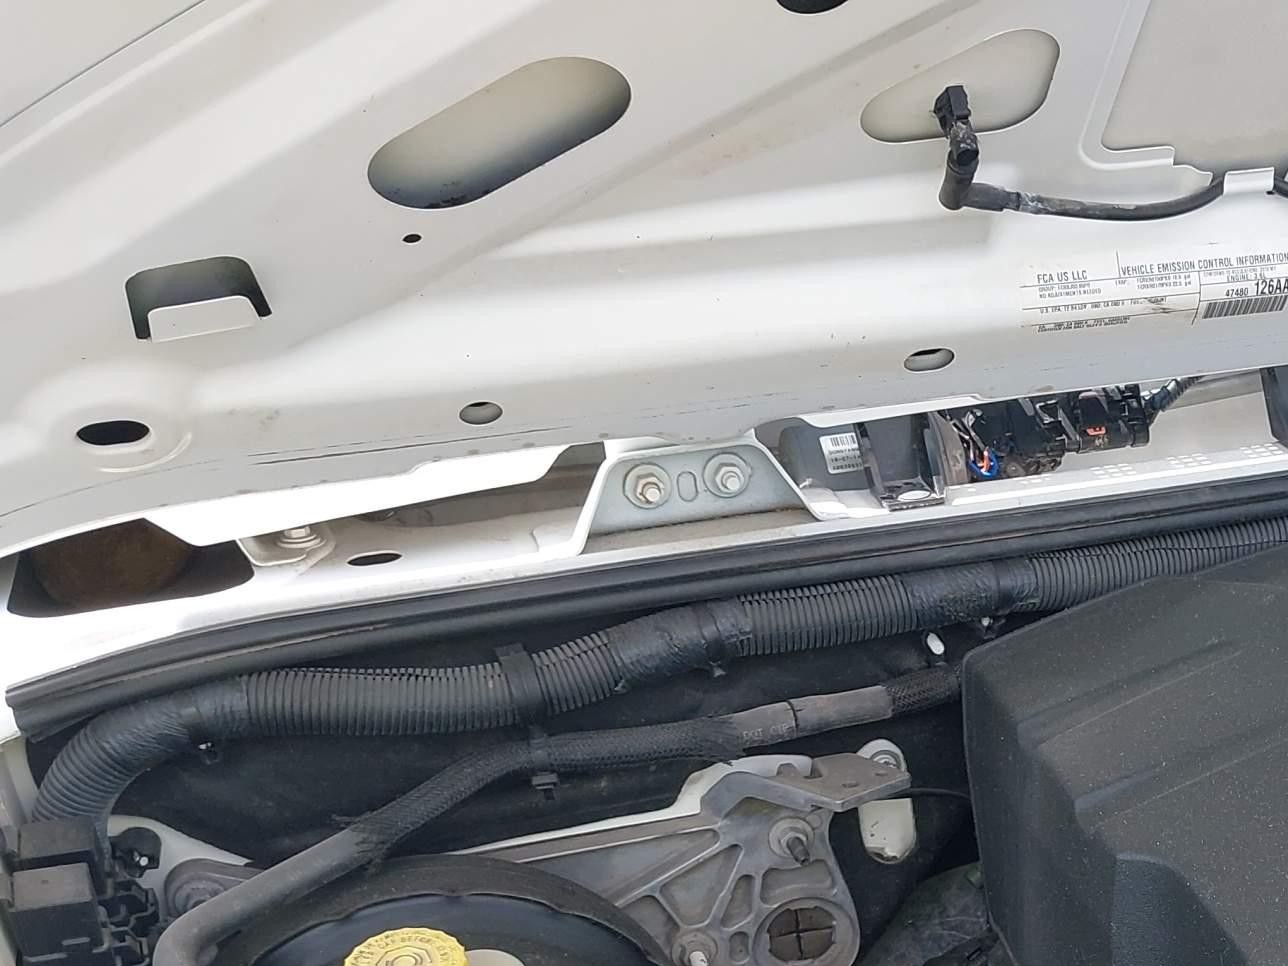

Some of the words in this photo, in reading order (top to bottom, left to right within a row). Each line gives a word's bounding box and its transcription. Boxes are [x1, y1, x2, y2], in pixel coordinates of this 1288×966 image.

[1121, 264, 1155, 276] VEHICLE
[1157, 260, 1195, 273] EMISSION
[1198, 257, 1232, 269] CONTROL
[1037, 272, 1054, 284] FCA
[1057, 271, 1069, 282] US
[1072, 269, 1088, 281] LLC
[1225, 287, 1249, 298] 47480
